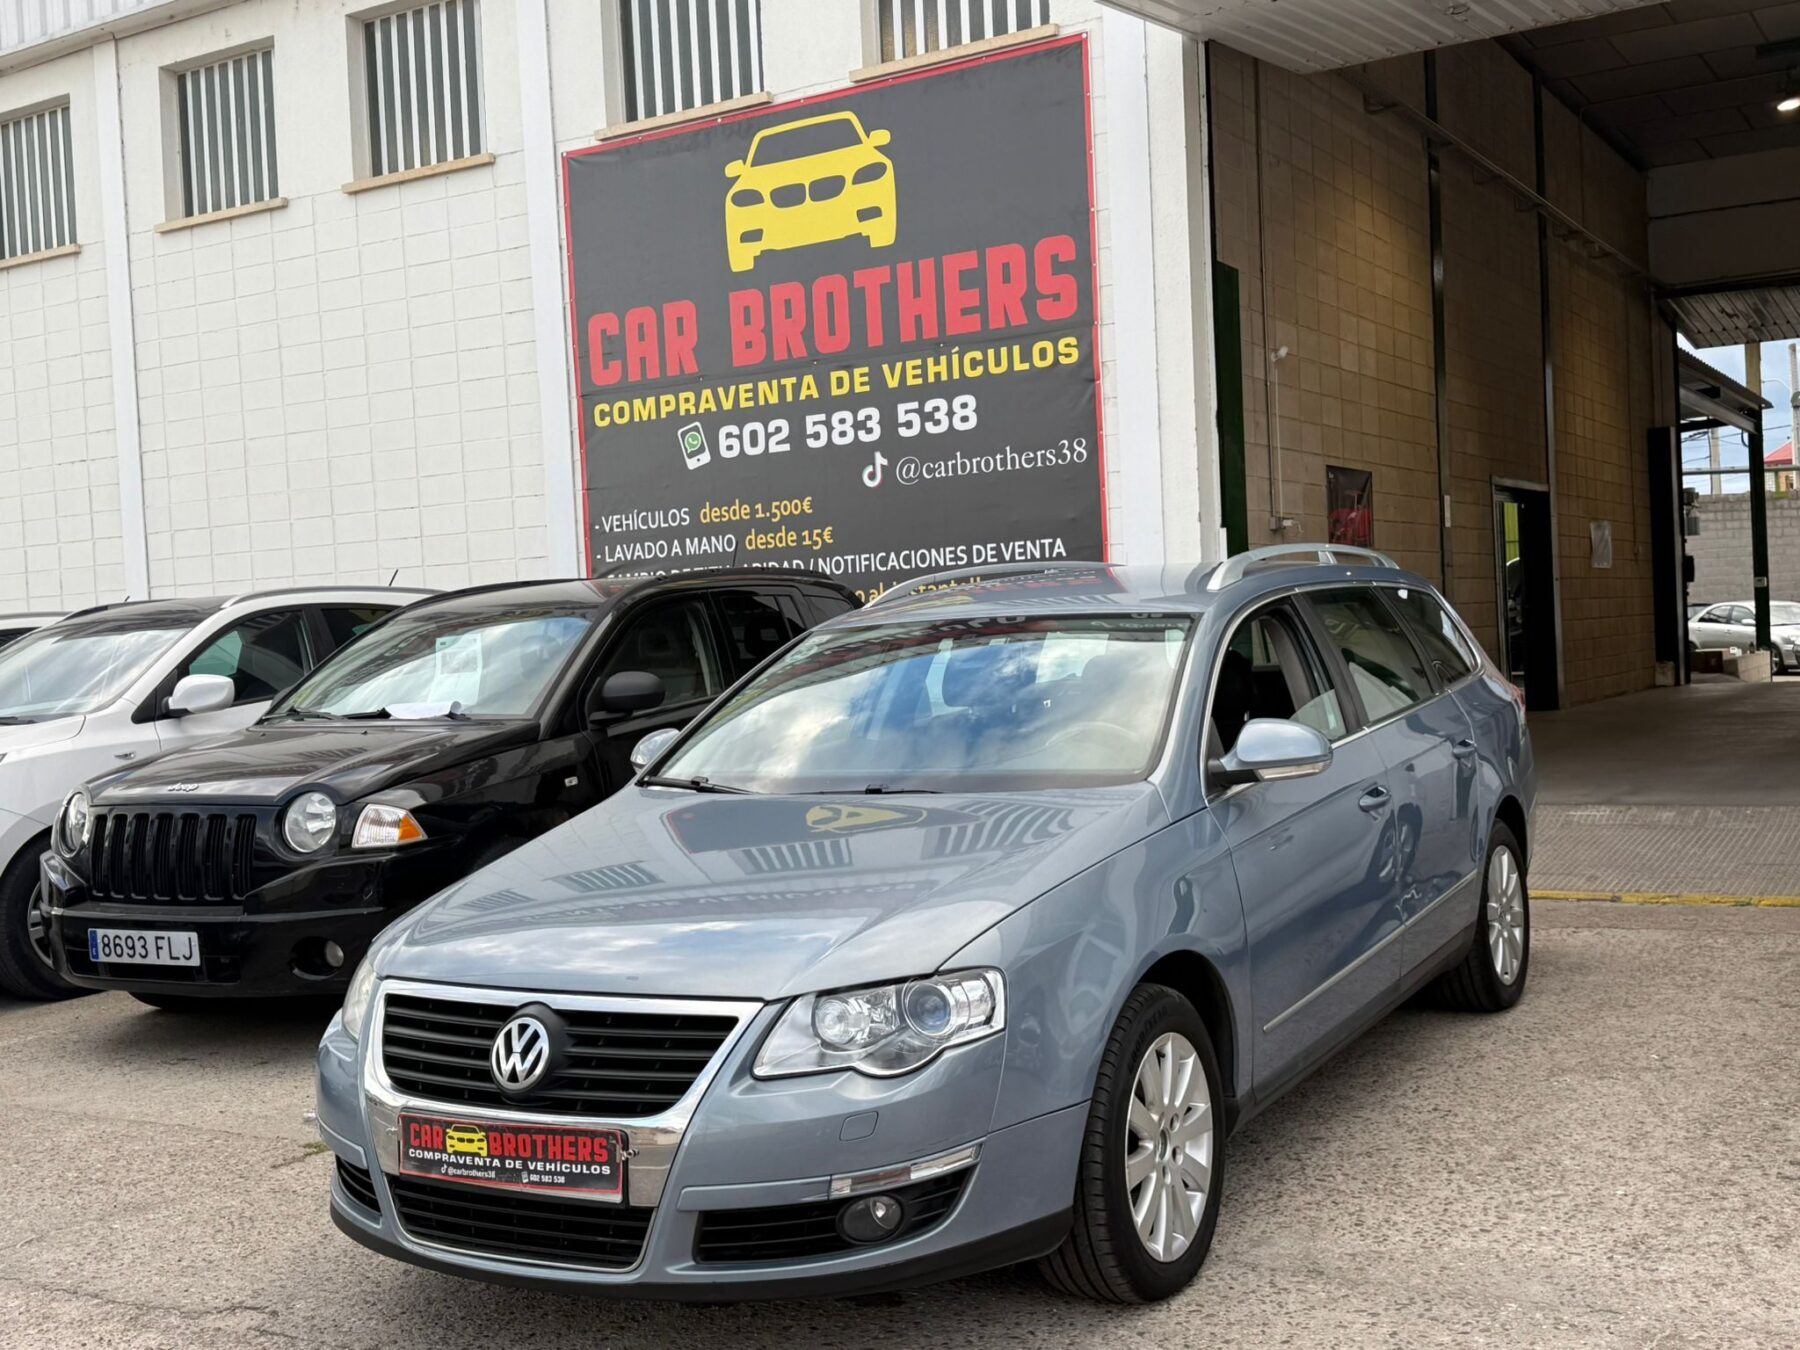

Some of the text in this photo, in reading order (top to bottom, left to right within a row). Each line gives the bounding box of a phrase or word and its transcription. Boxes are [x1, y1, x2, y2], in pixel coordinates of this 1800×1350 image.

[587, 235, 1078, 386] CAR BROTHERS
[593, 336, 1080, 428] COMPRAVENTA DE VEHÍCULOS
[718, 394, 977, 459] 602 583 538
[896, 438, 1087, 486] @carbrothers38
[700, 499, 750, 524] desde
[755, 496, 813, 522] 1.500€
[605, 540, 667, 563] LAVADO
[671, 539, 683, 556] A
[686, 535, 736, 555] MANO
[745, 526, 797, 550] desde
[802, 527, 833, 550] 15€
[818, 546, 967, 575] NOTIFICACIONES
[973, 543, 998, 563] DE
[1000, 538, 1066, 561] VENTA
[101, 934, 193, 961] 8693 FLJ
[409, 1148, 611, 1175] COMPRAVENTA DE VEHÍCULOS
[410, 1122, 608, 1163] CAR BROTHERS
